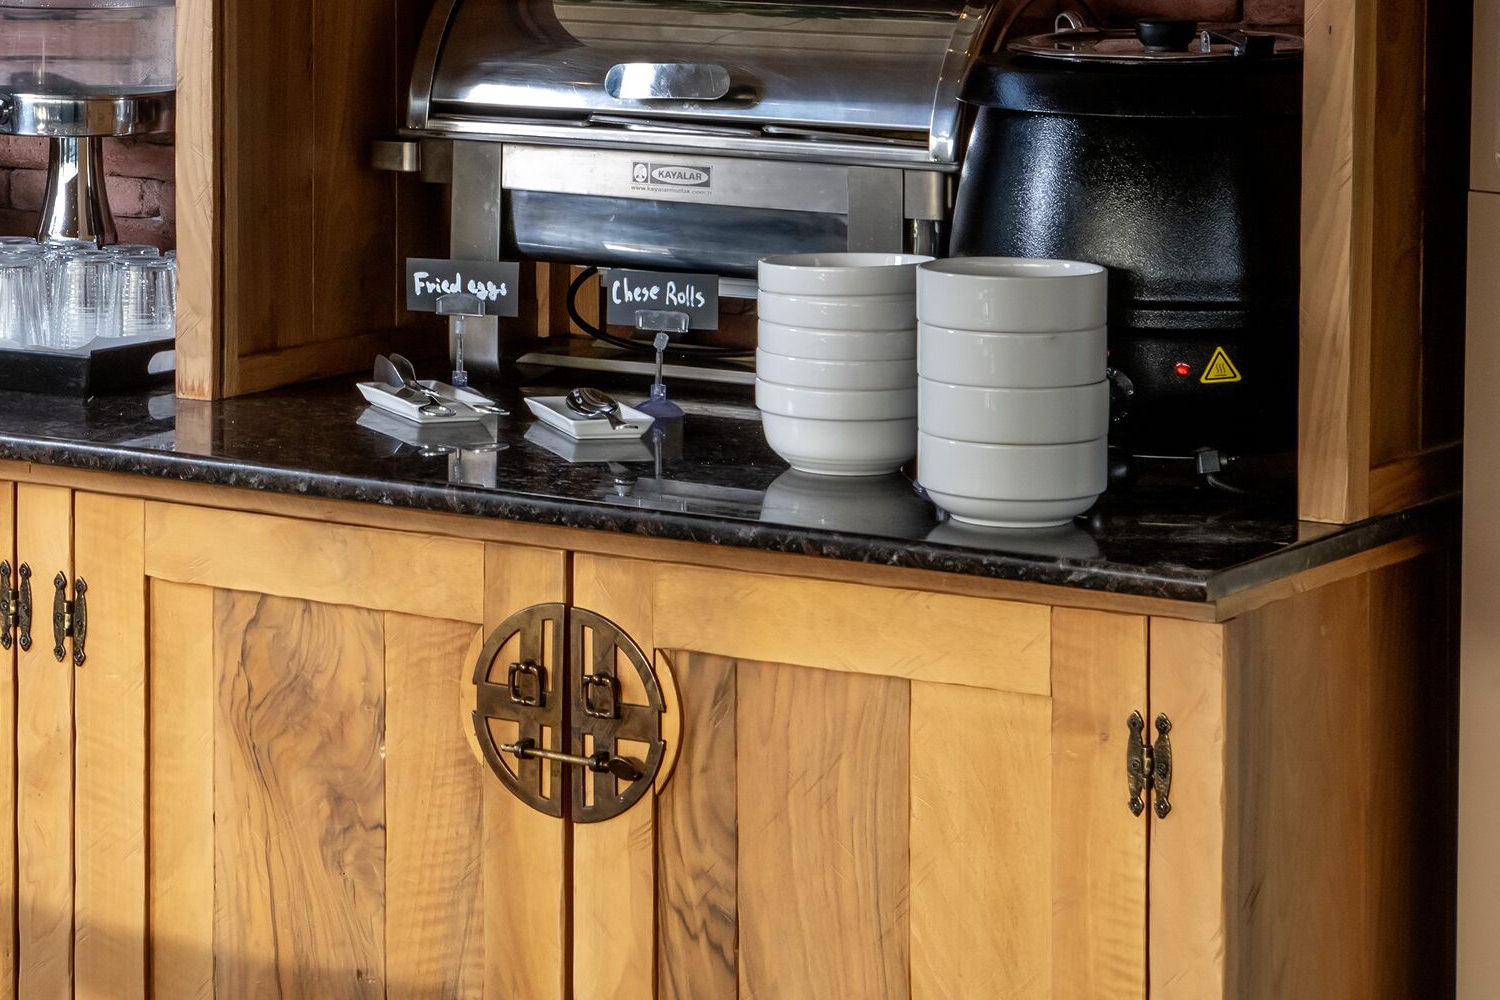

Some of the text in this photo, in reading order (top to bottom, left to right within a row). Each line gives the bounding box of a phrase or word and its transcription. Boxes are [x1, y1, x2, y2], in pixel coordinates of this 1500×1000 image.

[658, 170, 702, 181] KAYALAR
[413, 271, 507, 301] Fried eggs
[612, 277, 705, 307] Chese Rolls
